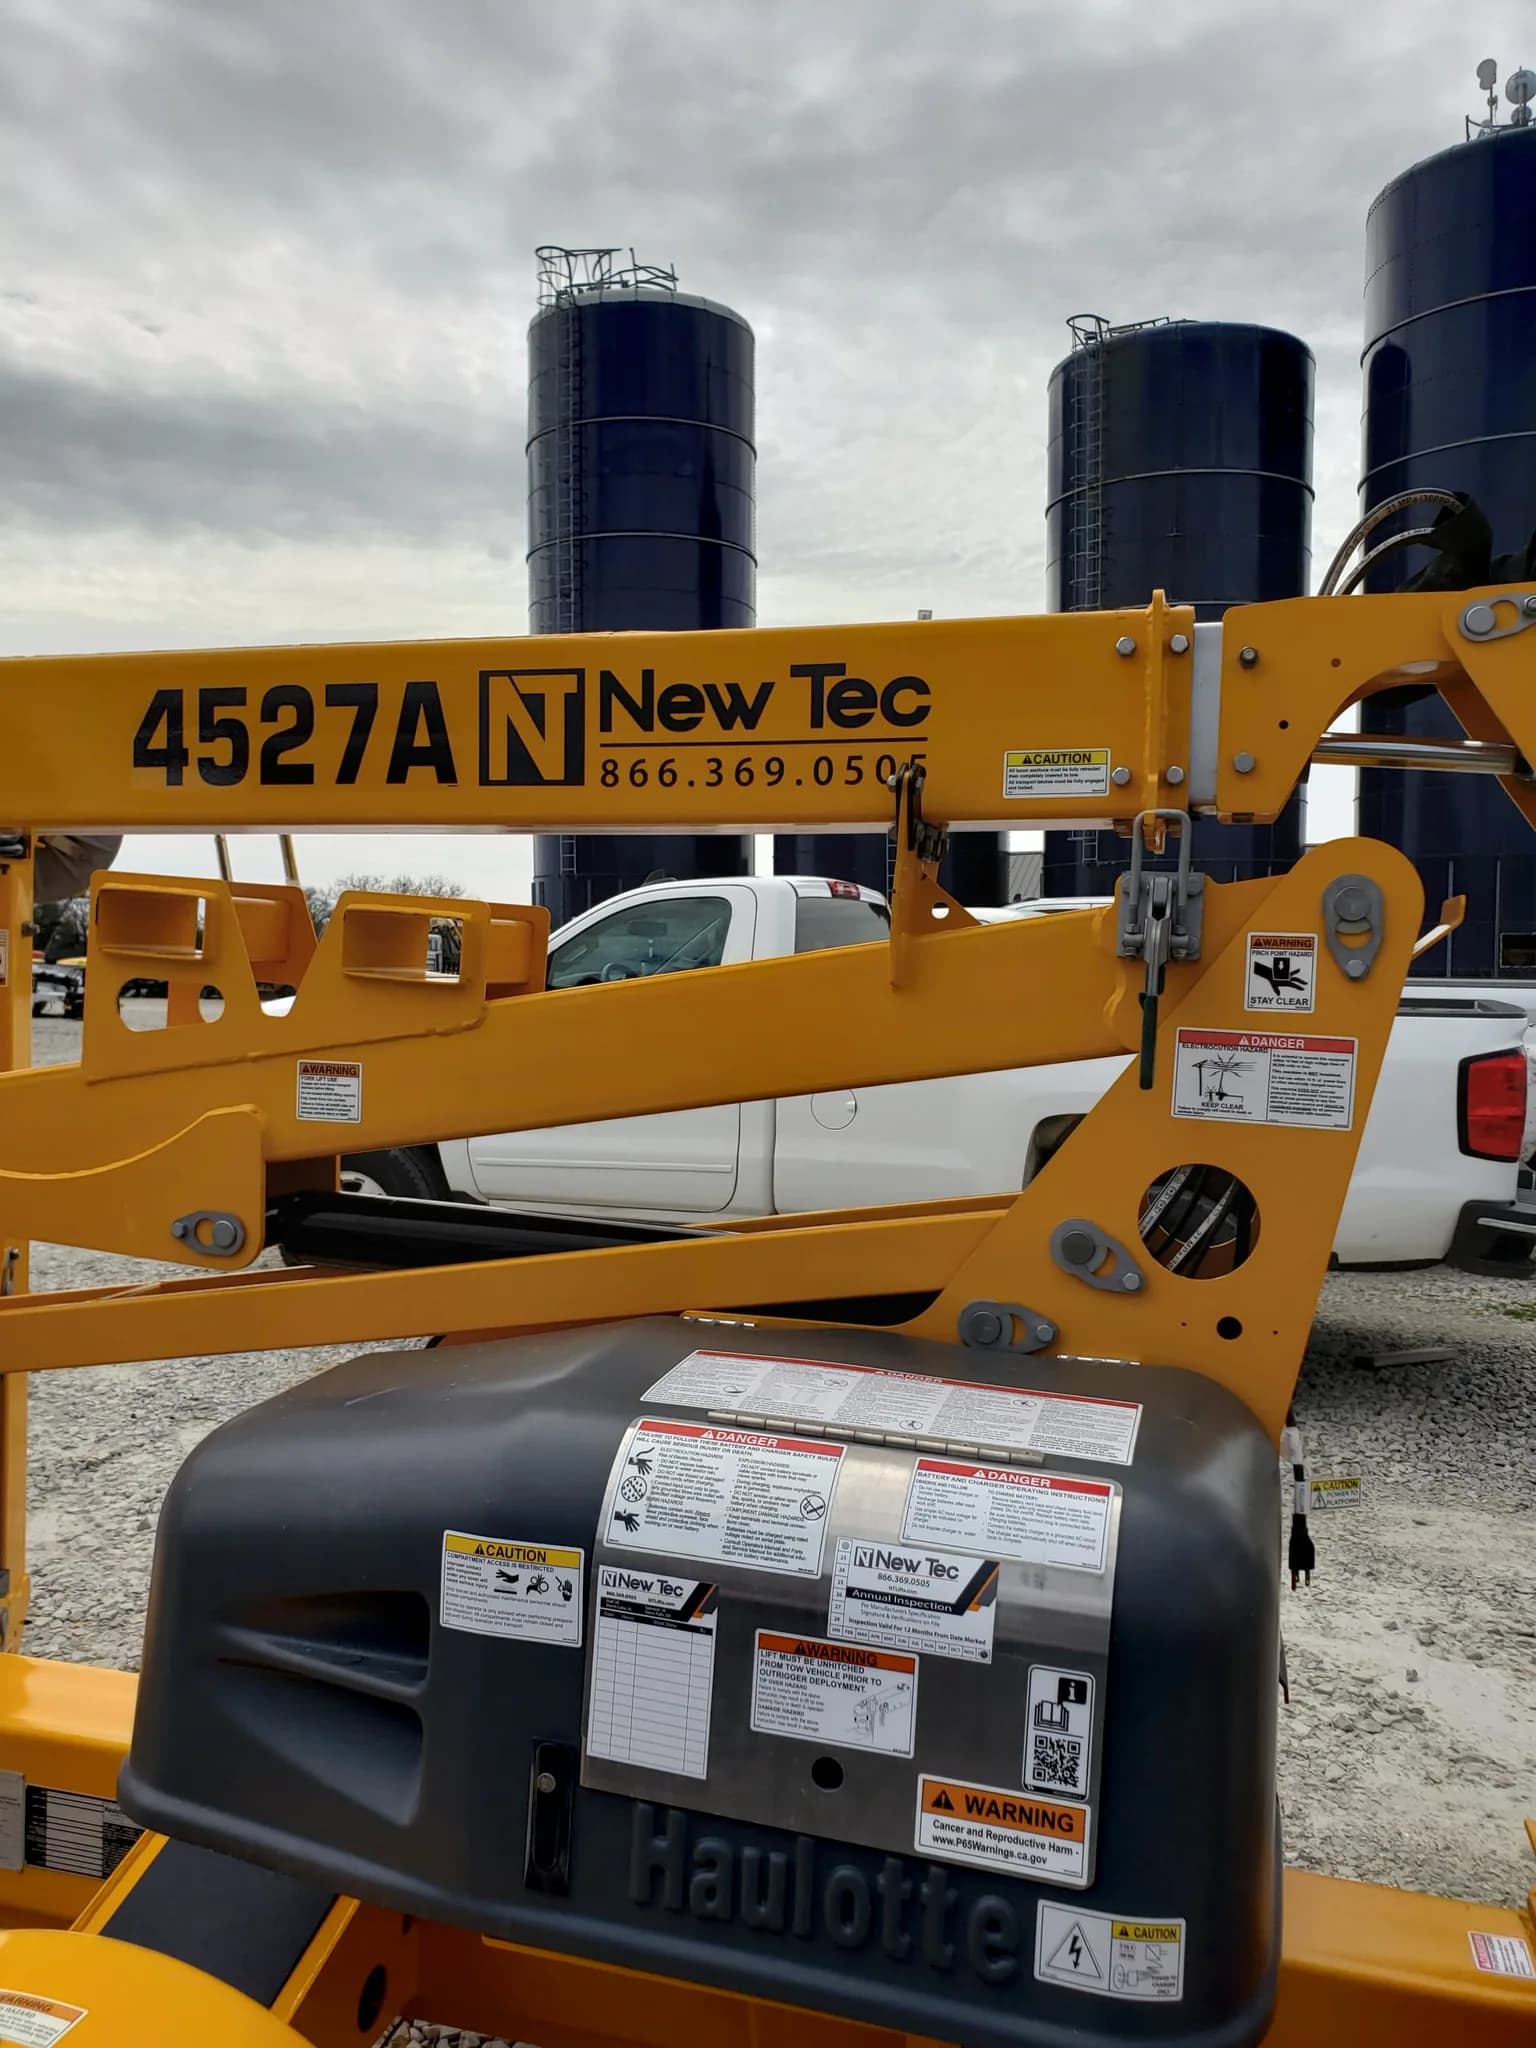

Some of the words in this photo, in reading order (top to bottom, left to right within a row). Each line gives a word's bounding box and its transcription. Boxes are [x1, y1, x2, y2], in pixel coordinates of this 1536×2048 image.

[602, 669, 775, 732] New
[790, 663, 933, 729] Tec
[132, 682, 458, 787] 4527A
[483, 671, 582, 784] NT
[1034, 753, 1091, 764] CAUTION
[1263, 938, 1312, 948] WARNING
[1250, 997, 1274, 1005] STAY
[1276, 998, 1309, 1006] CLEAR
[1183, 1043, 1238, 1051] ELECTROCUTION
[1252, 1037, 1305, 1049] DANGER
[310, 1065, 356, 1075] WARNING
[716, 1431, 778, 1447] DANGER
[761, 1448, 792, 1456] CHARGER
[918, 1472, 948, 1481] BATTERY
[968, 1480, 1005, 1489] CHARGER
[1006, 1485, 1049, 1495] OPERATING
[1051, 1491, 1106, 1503] INSTRUCTIONS
[988, 1471, 1051, 1488] DANGER
[1323, 1480, 1358, 1490] CAUTION
[447, 1552, 486, 1563] COMPARTMENT
[487, 1558, 510, 1567] ACCESS
[518, 1563, 554, 1574] RESTRICTED
[486, 1544, 546, 1564] CAUTION
[876, 1550, 921, 1574] New
[924, 1557, 960, 1580] Tec
[618, 1573, 654, 1592] New
[656, 1579, 684, 1597] Tec
[877, 1573, 930, 1588] 866.369.0505
[853, 1589, 891, 1603] Annual
[894, 1596, 952, 1614] Inspection
[849, 1617, 878, 1628] Inspection
[879, 1622, 893, 1630] Valid
[912, 1628, 933, 1637] Months
[934, 1631, 949, 1639] From
[949, 1634, 963, 1642] Date
[964, 1636, 986, 1645] Marked
[761, 1651, 776, 1660] LIFT
[779, 1654, 801, 1664] MUST
[804, 1658, 814, 1666] BE
[817, 1660, 864, 1674] UNHITCHED
[807, 1644, 877, 1667] WARNING
[760, 1660, 784, 1670] FROM
[786, 1664, 804, 1674] TOW
[806, 1667, 840, 1680] VEHICLE
[843, 1673, 868, 1684] PRIOR
[870, 1678, 882, 1686] TO
[760, 1669, 807, 1683] OUTRIGGER
[809, 1677, 867, 1693] DEPLOYMENT.
[784, 1682, 807, 1690] HAZARD
[758, 1704, 780, 1712] DAMAGE
[782, 1708, 804, 1716] HAZARD
[964, 1793, 1074, 1833] WARNING
[933, 1819, 964, 1834] Cancer
[966, 1826, 984, 1838] and
[986, 1830, 1046, 1850] Reproductive
[1049, 1842, 1073, 1856] Harm
[932, 1835, 1048, 1865] www.P65Warnings.ca.gov
[630, 1801, 1019, 1981] Haulotte
[1134, 1926, 1177, 1940] CAUTION
